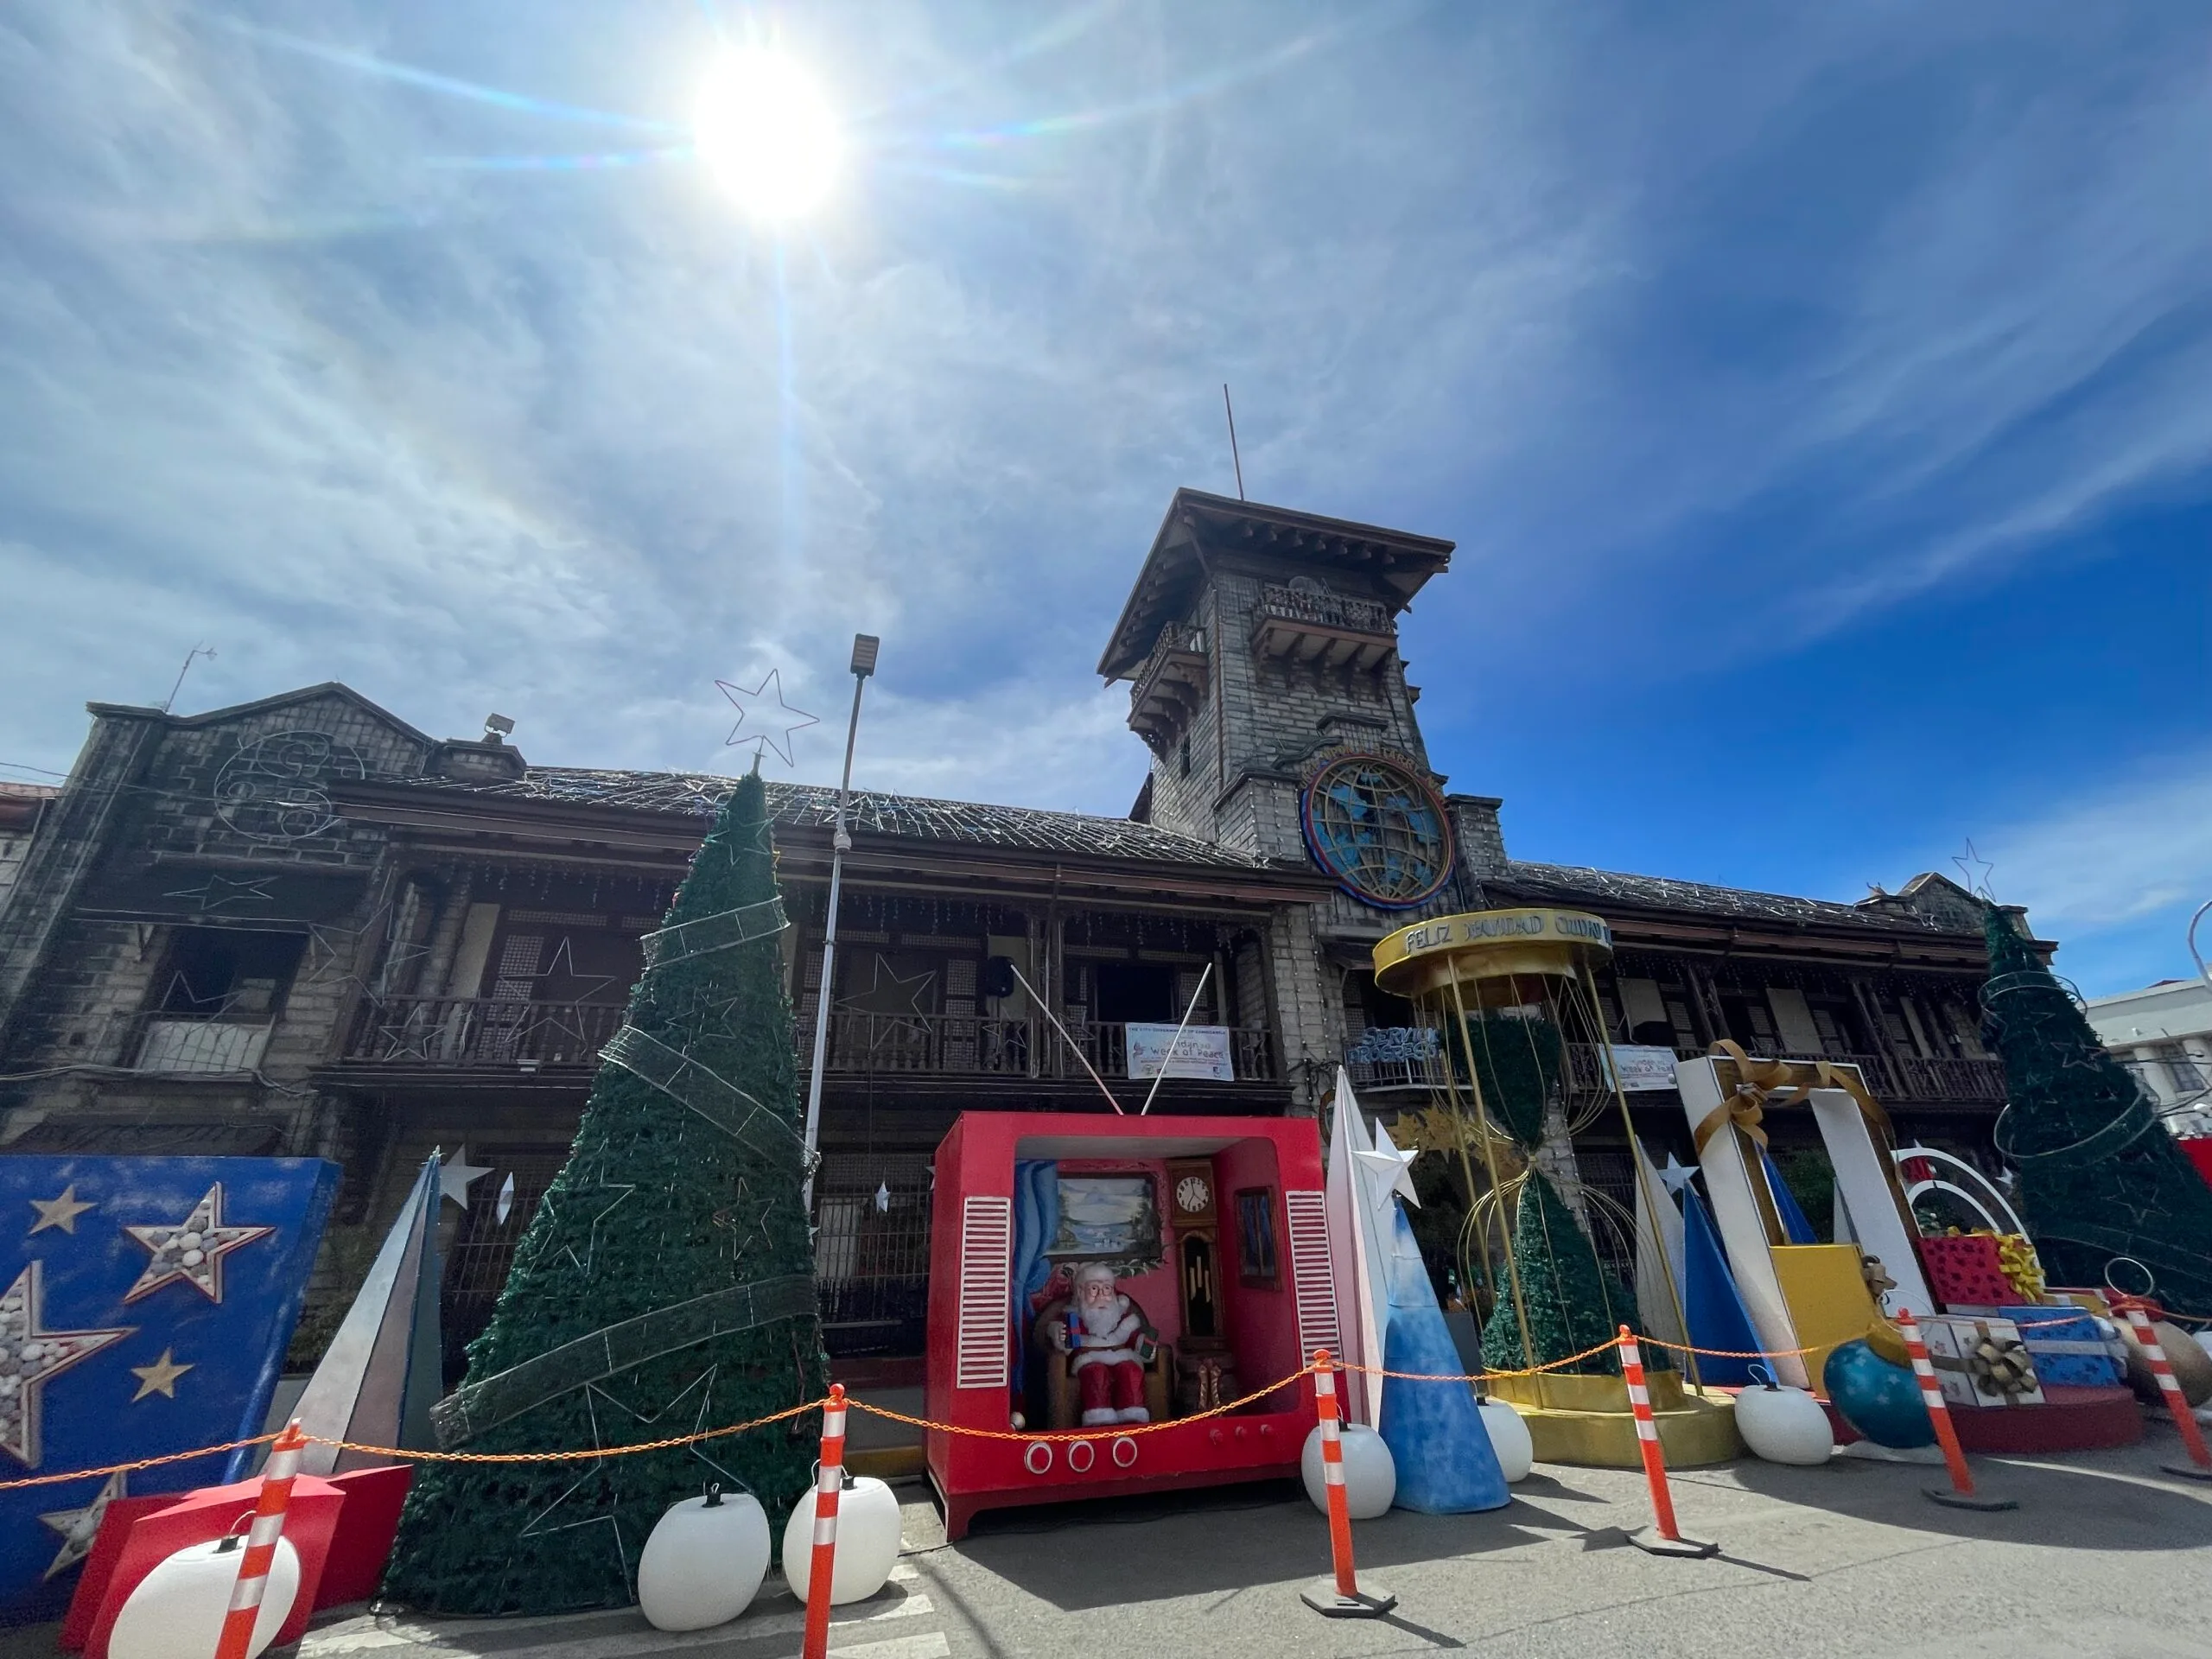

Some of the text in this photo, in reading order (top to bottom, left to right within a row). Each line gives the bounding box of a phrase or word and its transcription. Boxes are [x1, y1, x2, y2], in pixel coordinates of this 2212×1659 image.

[1406, 923, 1453, 956] FELIZ
[1182, 1047, 1192, 1056] of
[1198, 1048, 1224, 1058] Peace
